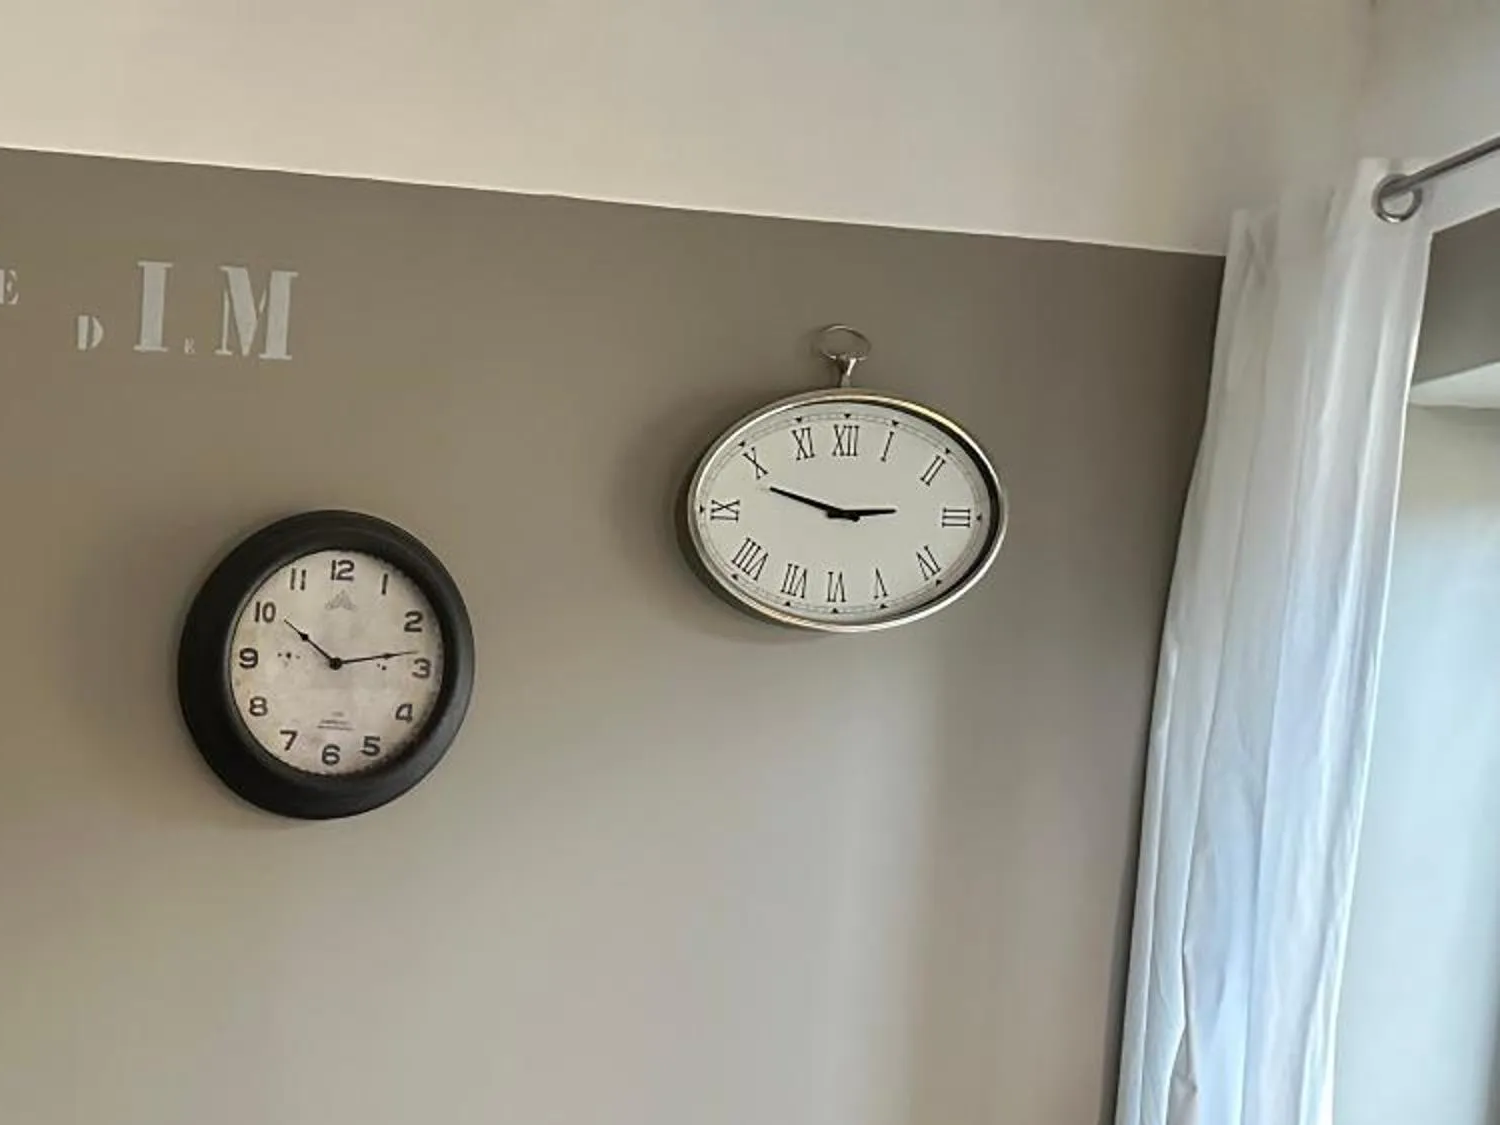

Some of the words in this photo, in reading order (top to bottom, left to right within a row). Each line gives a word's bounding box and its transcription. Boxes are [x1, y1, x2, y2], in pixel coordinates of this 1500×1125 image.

[791, 426, 816, 461] XI
[832, 423, 861, 458] XII
[880, 430, 895, 463] I
[742, 446, 769, 480] X
[920, 454, 947, 486] II
[710, 499, 741, 523] IX
[941, 507, 971, 529] III
[330, 559, 354, 582] 12
[730, 537, 769, 581] VIII
[915, 545, 942, 581] IV
[289, 568, 307, 591] 11
[381, 573, 389, 596] 1
[780, 562, 808, 599] VII
[826, 571, 847, 603] VI
[873, 567, 889, 600] V
[254, 601, 277, 624] 10
[404, 611, 423, 632] 2
[239, 648, 259, 670] 9
[412, 657, 431, 679] 3
[249, 696, 269, 717] 8
[395, 703, 413, 722] 4
[279, 729, 299, 751] 7
[363, 735, 381, 757] 5
[321, 743, 341, 766] 6
